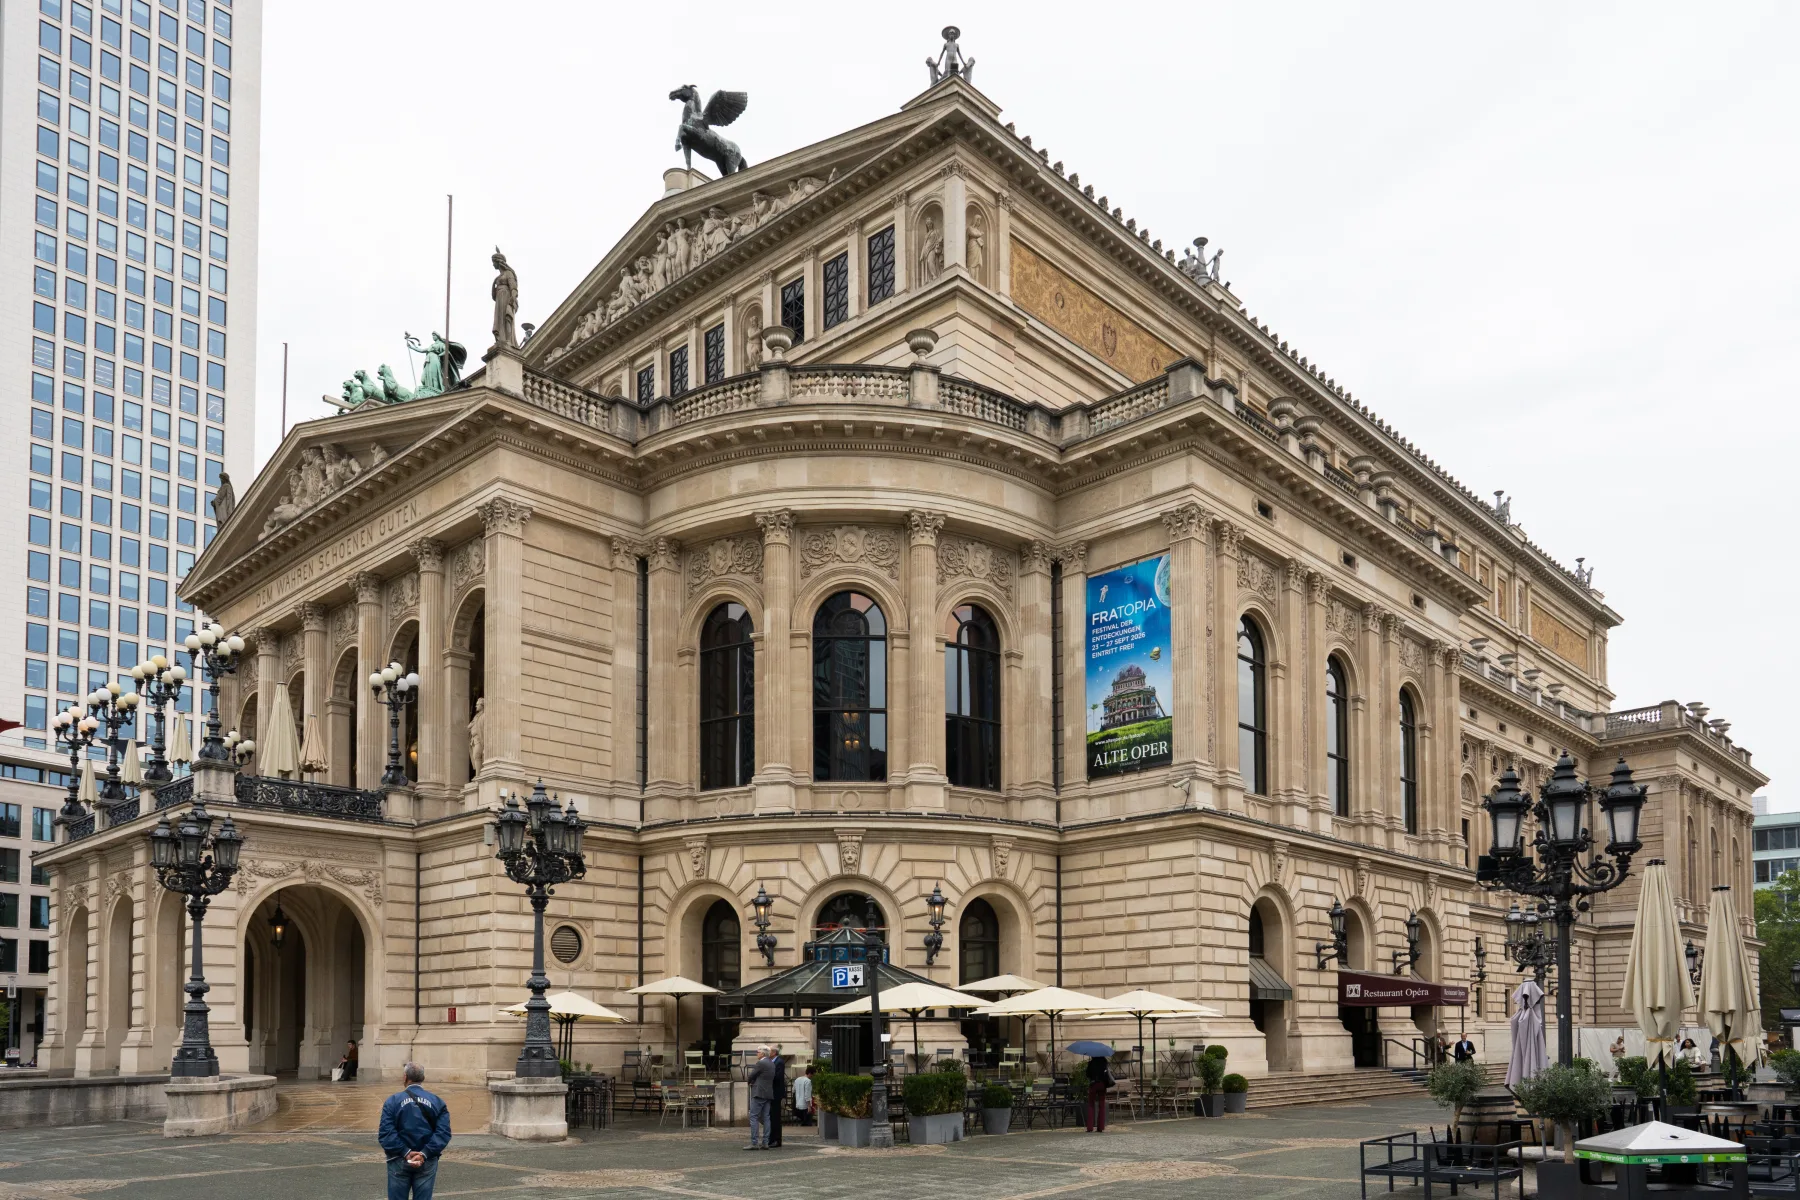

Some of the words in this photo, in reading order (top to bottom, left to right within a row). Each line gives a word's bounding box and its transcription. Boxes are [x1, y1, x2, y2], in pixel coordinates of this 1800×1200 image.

[256, 584, 273, 609] DEM
[276, 560, 314, 596] WAHREN
[319, 526, 373, 571] SCHOENEN
[1092, 597, 1157, 626] FRATOPIA
[1092, 623, 1119, 635] FESTIVAL
[1120, 619, 1134, 628] DER
[1092, 625, 1141, 643] ENTDECKUNGEN
[1106, 640, 1114, 648] 27
[1114, 636, 1130, 645] SEPT
[1131, 631, 1146, 641] 2026
[1092, 647, 1119, 659] EINTRITT
[1119, 643, 1135, 652] FREI!
[1093, 748, 1129, 767] ALTE
[1131, 741, 1169, 760] OPER
[836, 972, 846, 986] P
[1363, 989, 1404, 998] Restaurant
[1405, 987, 1429, 998] Opéra
